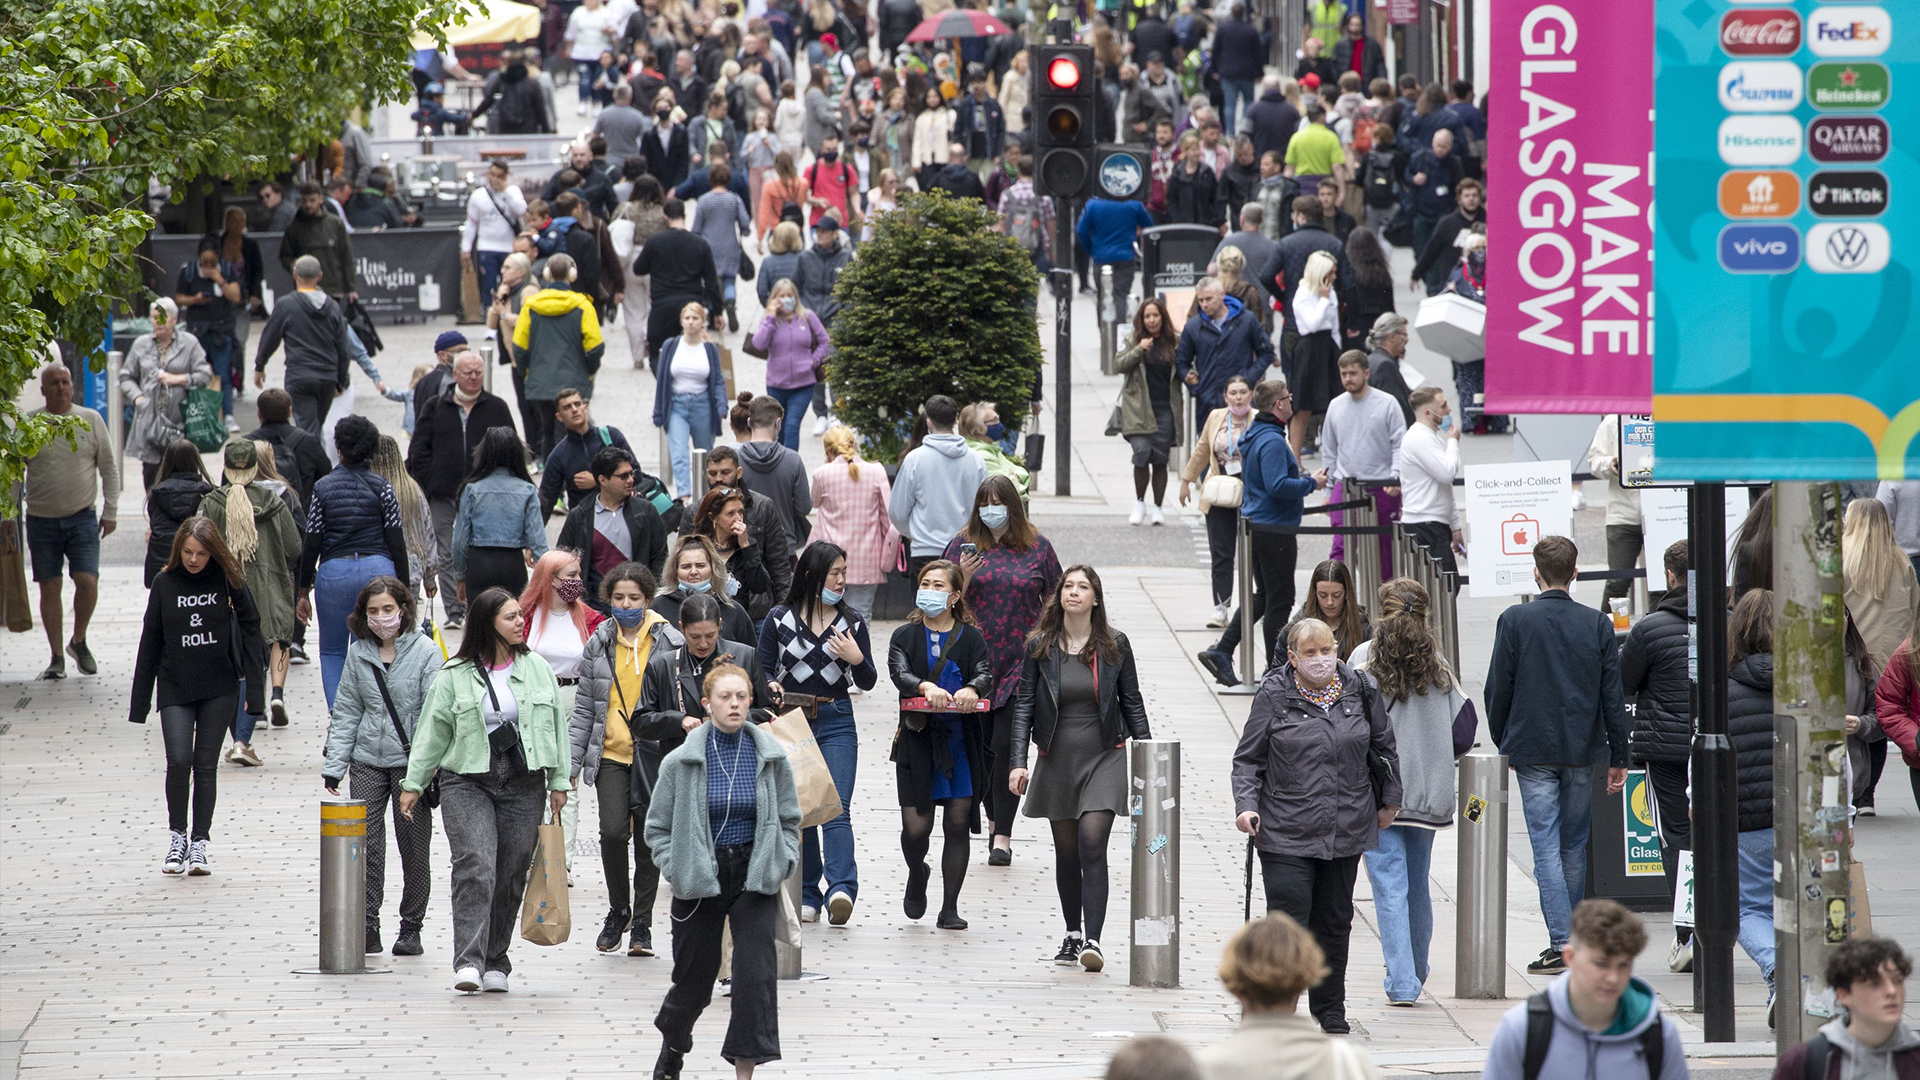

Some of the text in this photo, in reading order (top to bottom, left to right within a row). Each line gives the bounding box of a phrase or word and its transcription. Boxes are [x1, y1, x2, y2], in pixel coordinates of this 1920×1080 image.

[1817, 21, 1880, 41] FedEx
[1816, 88, 1882, 103] Heineken
[1724, 133, 1797, 147] Hisense
[1814, 125, 1882, 146] QATAR
[1830, 143, 1883, 154] AIRWAYS
[1517, 4, 1578, 355] GLASGOW
[1829, 187, 1885, 203] TikTok
[1733, 238, 1788, 255] vivo
[1582, 162, 1640, 356] MAKE
[1475, 476, 1562, 490] Click-and-Collect
[177, 592, 217, 608] ROCK
[190, 613, 203, 627] &
[181, 631, 218, 647] ROLL
